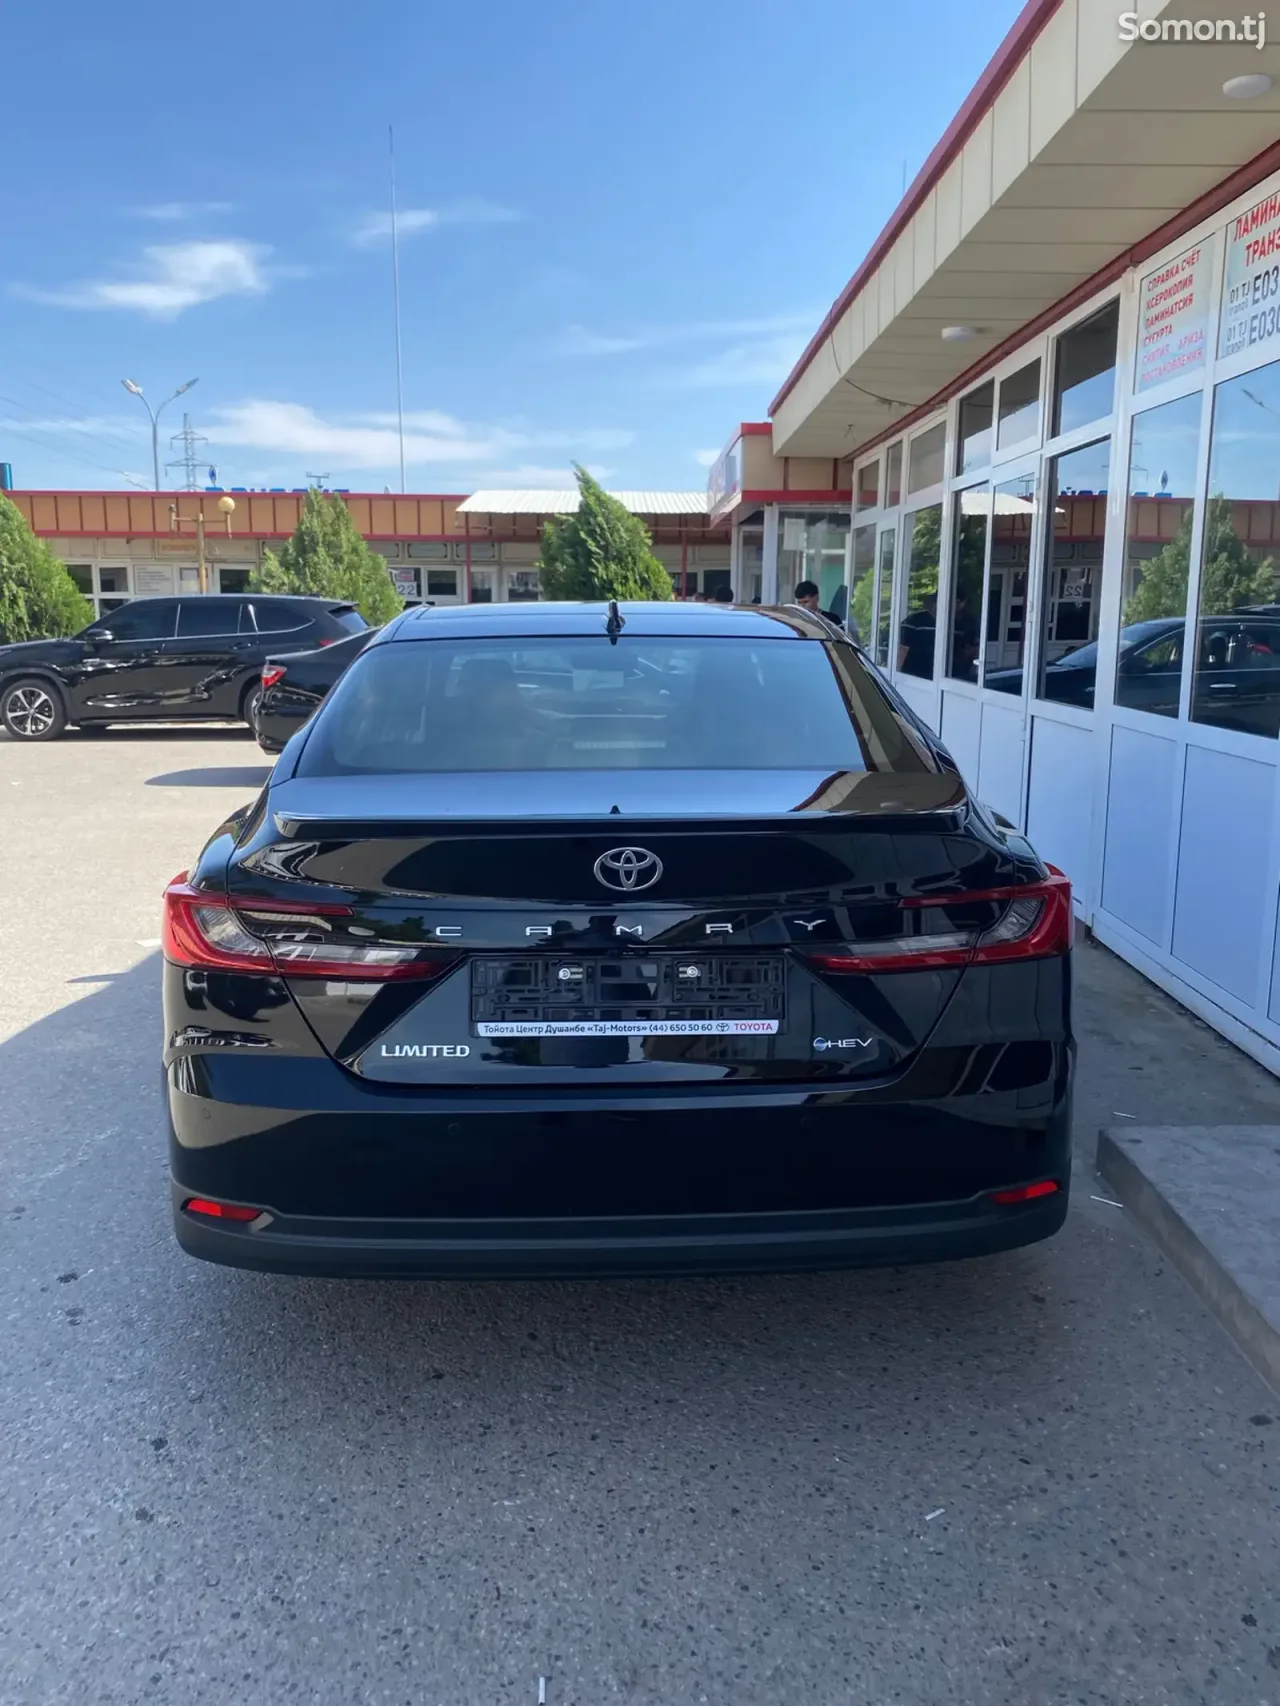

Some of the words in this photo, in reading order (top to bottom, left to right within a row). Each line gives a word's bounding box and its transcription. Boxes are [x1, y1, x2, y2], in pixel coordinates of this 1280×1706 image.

[1148, 264, 1179, 292] СПРАВКА
[1147, 274, 1193, 310] КСЕРОКОПИЯ
[398, 584, 415, 596] 22
[435, 919, 826, 937] CAMRY
[484, 1025, 515, 1033] Тойота
[516, 1025, 543, 1034] Центр
[545, 1024, 586, 1034] Душанбе
[649, 1023, 668, 1032] (44)
[669, 1023, 687, 1032] 650
[688, 1023, 700, 1032] 50
[701, 1023, 713, 1032] 60
[734, 1022, 773, 1031] TOYOTA
[381, 1044, 470, 1057] LIMITED
